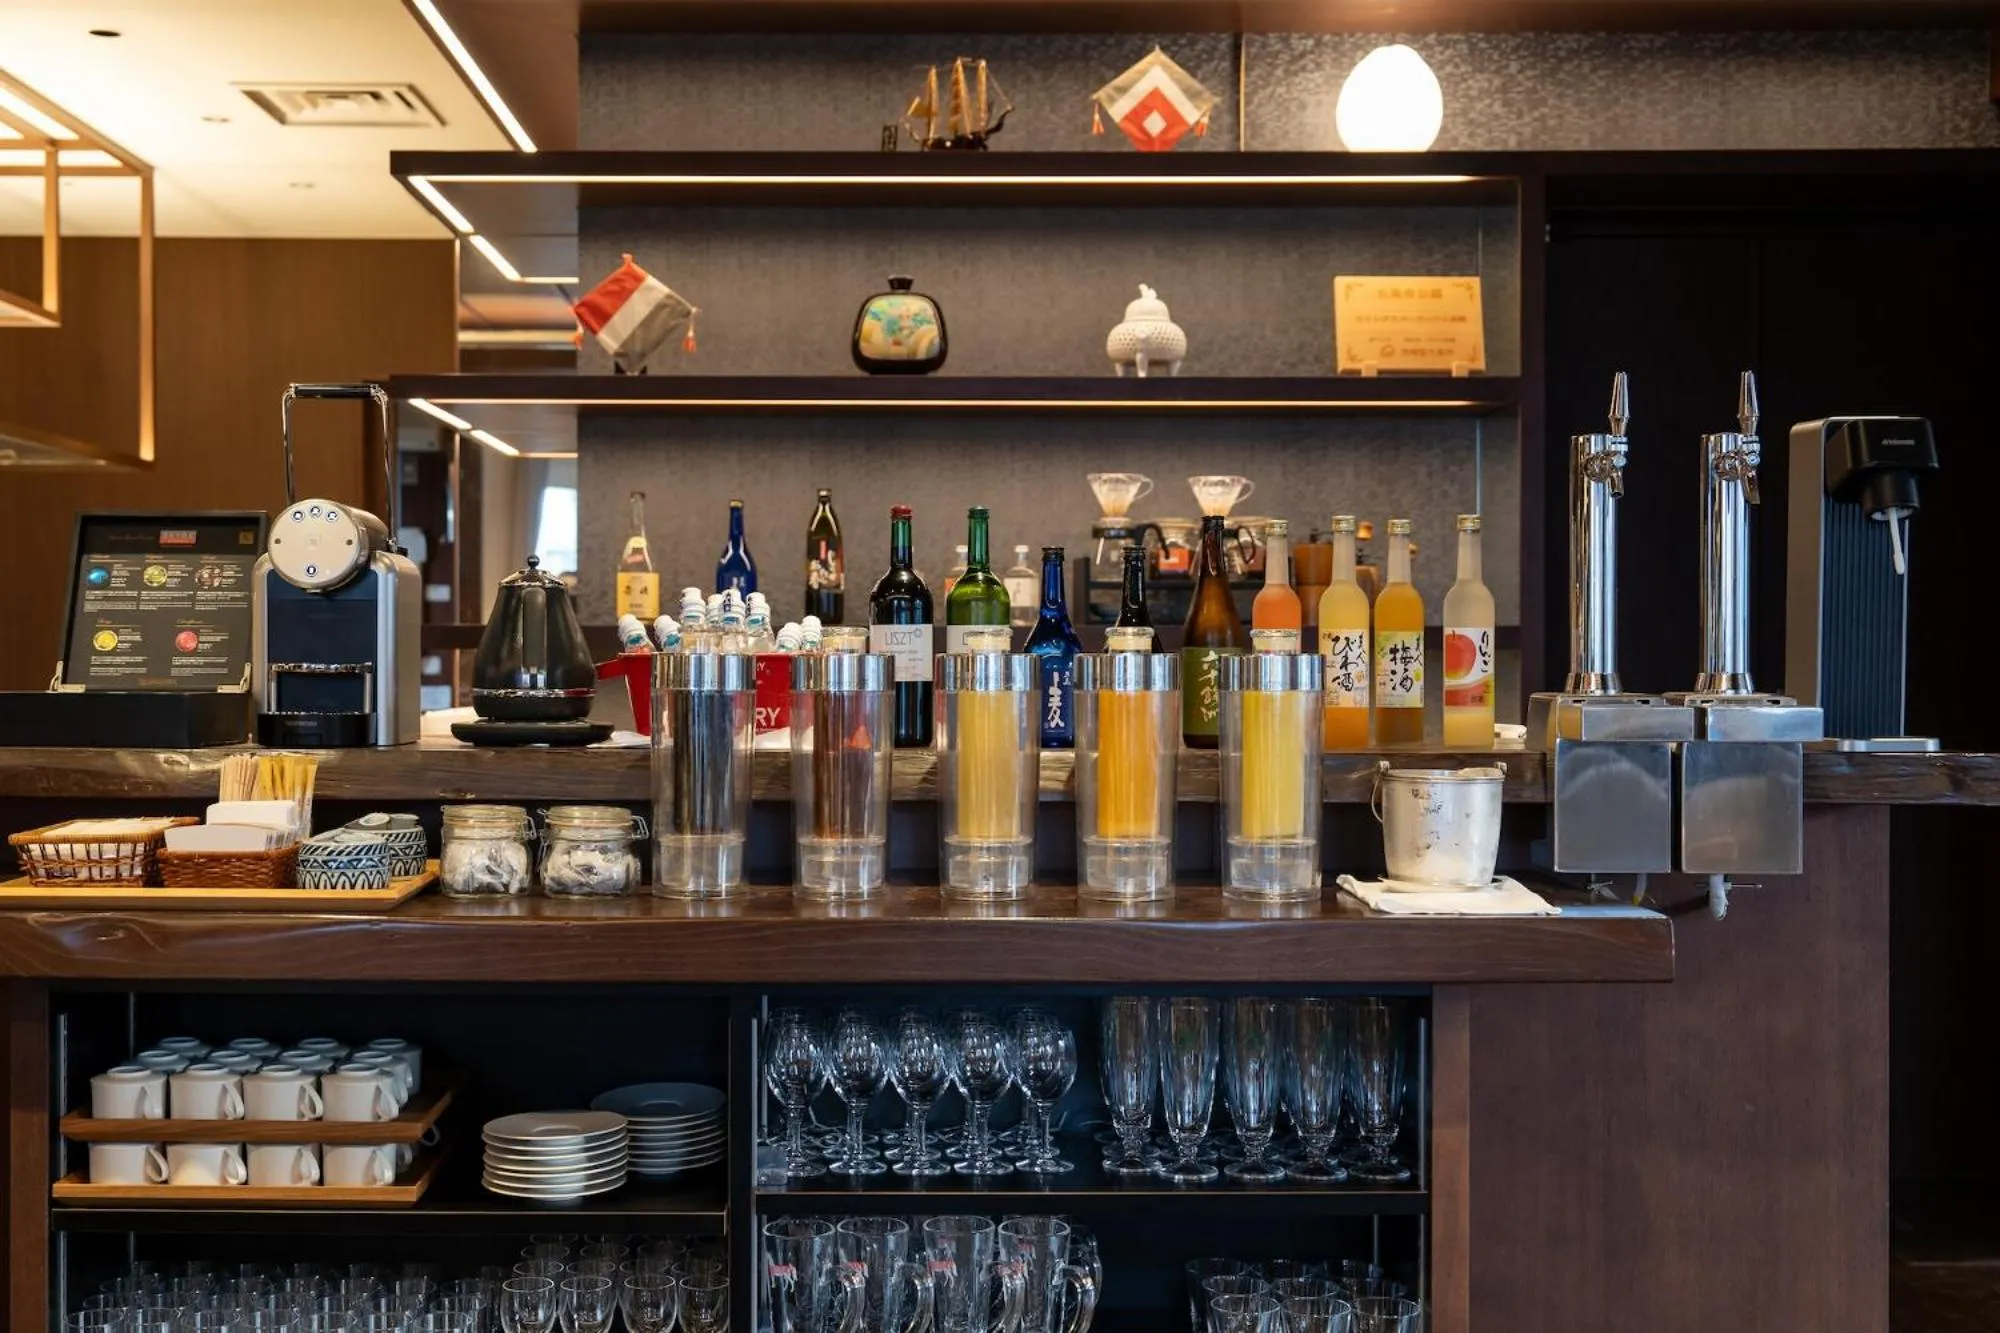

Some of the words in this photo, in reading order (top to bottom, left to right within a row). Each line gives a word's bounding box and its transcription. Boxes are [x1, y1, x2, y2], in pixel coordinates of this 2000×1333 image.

[885, 631, 913, 646] LISZT
[1478, 630, 1491, 673] りんご
[1332, 634, 1359, 692] びわ酒
[1389, 639, 1414, 693] 梅酒
[755, 707, 781, 728] RY
